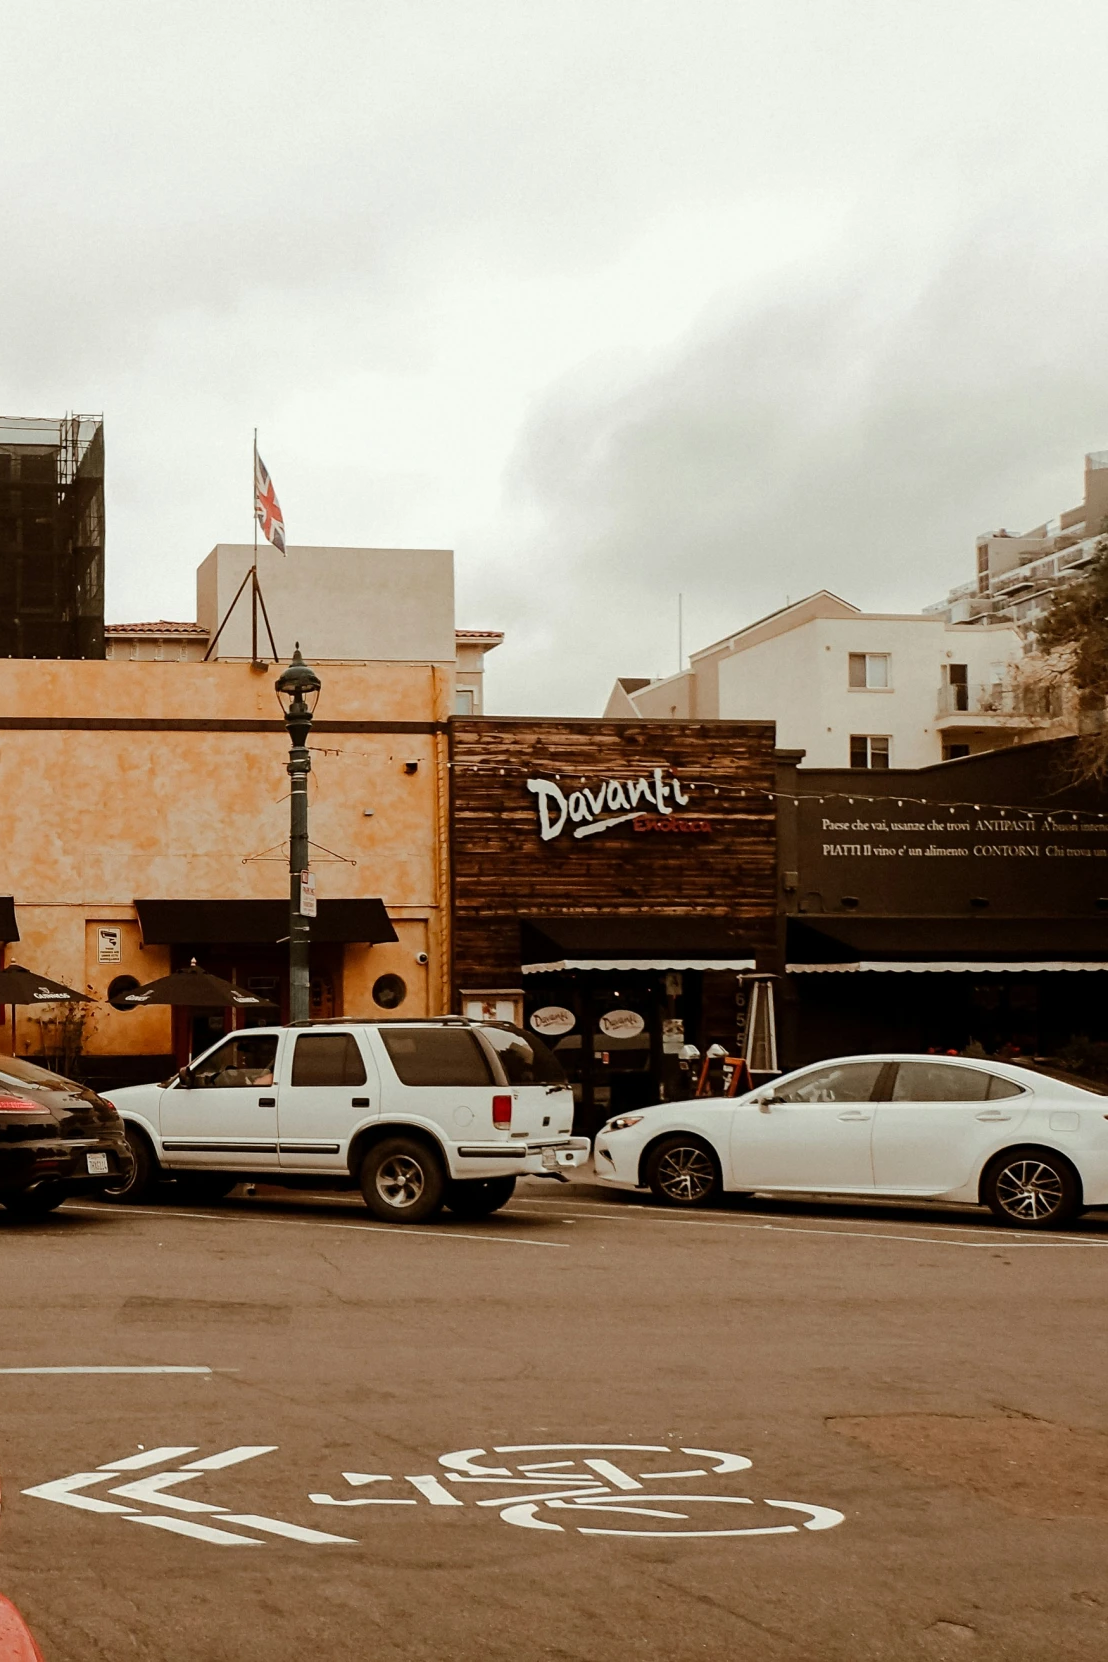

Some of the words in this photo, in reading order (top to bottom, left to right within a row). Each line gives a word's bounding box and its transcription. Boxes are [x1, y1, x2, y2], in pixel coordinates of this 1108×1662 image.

[527, 767, 689, 841] Davanti
[821, 819, 850, 832] Paese
[851, 819, 870, 832] che
[871, 819, 890, 834] vai,
[890, 822, 926, 832] usanze
[928, 819, 945, 832] che
[946, 819, 970, 832] trovi
[975, 820, 1036, 832] ANTIPASTI
[823, 844, 861, 856] PIATTI
[873, 844, 897, 857] vino
[908, 847, 923, 857] un
[924, 844, 969, 857] alimento
[973, 844, 1040, 857] CONTORNI
[1045, 845, 1065, 857] Chi
